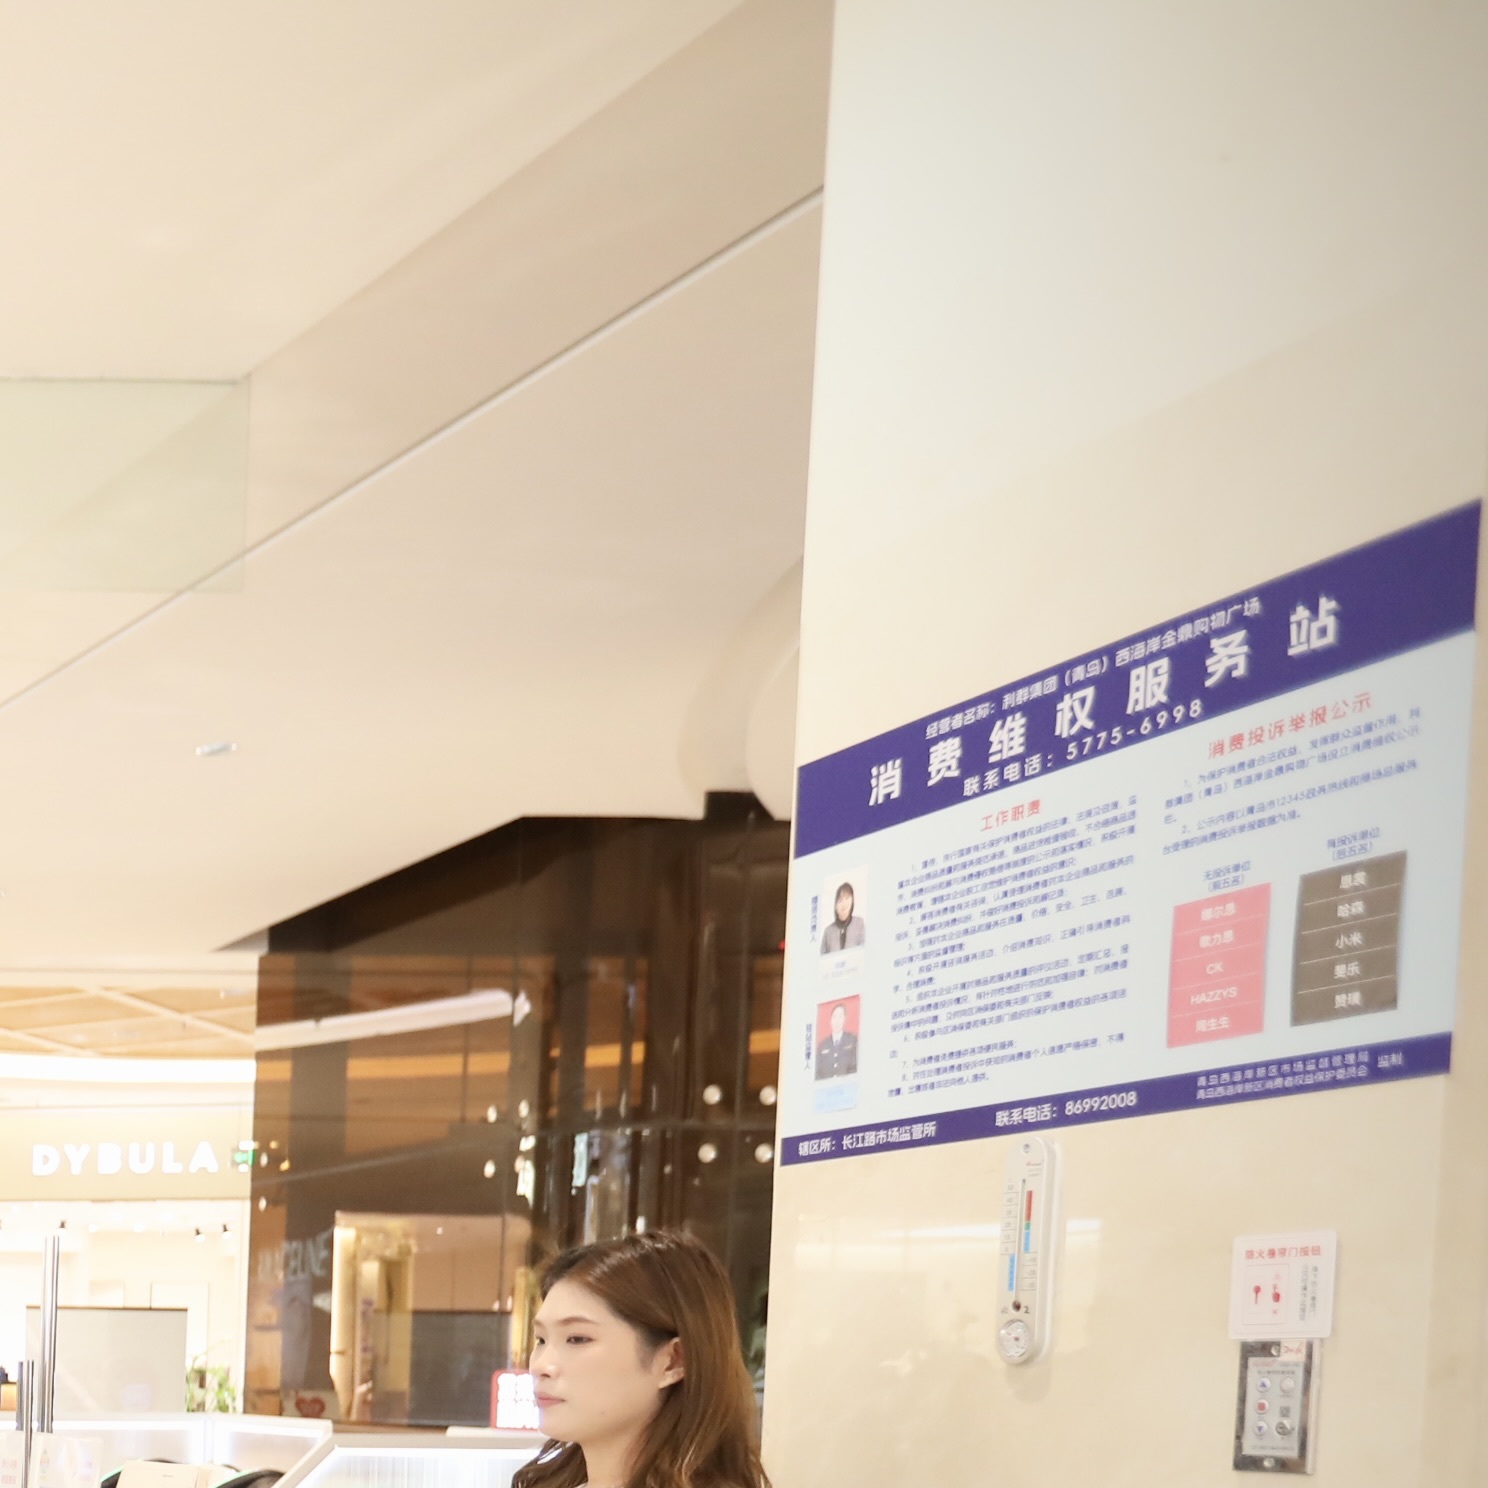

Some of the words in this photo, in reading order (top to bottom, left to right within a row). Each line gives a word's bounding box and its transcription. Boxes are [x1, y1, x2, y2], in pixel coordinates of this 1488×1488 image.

[868, 588, 1342, 808] 消费维权服务站
[1208, 690, 1372, 759] 消费投诉举报公示
[1335, 929, 1363, 950] 小米
[1205, 960, 1224, 975] CK
[1190, 986, 1237, 1006] HAZZYS
[31, 1140, 219, 1177] DYBULA
